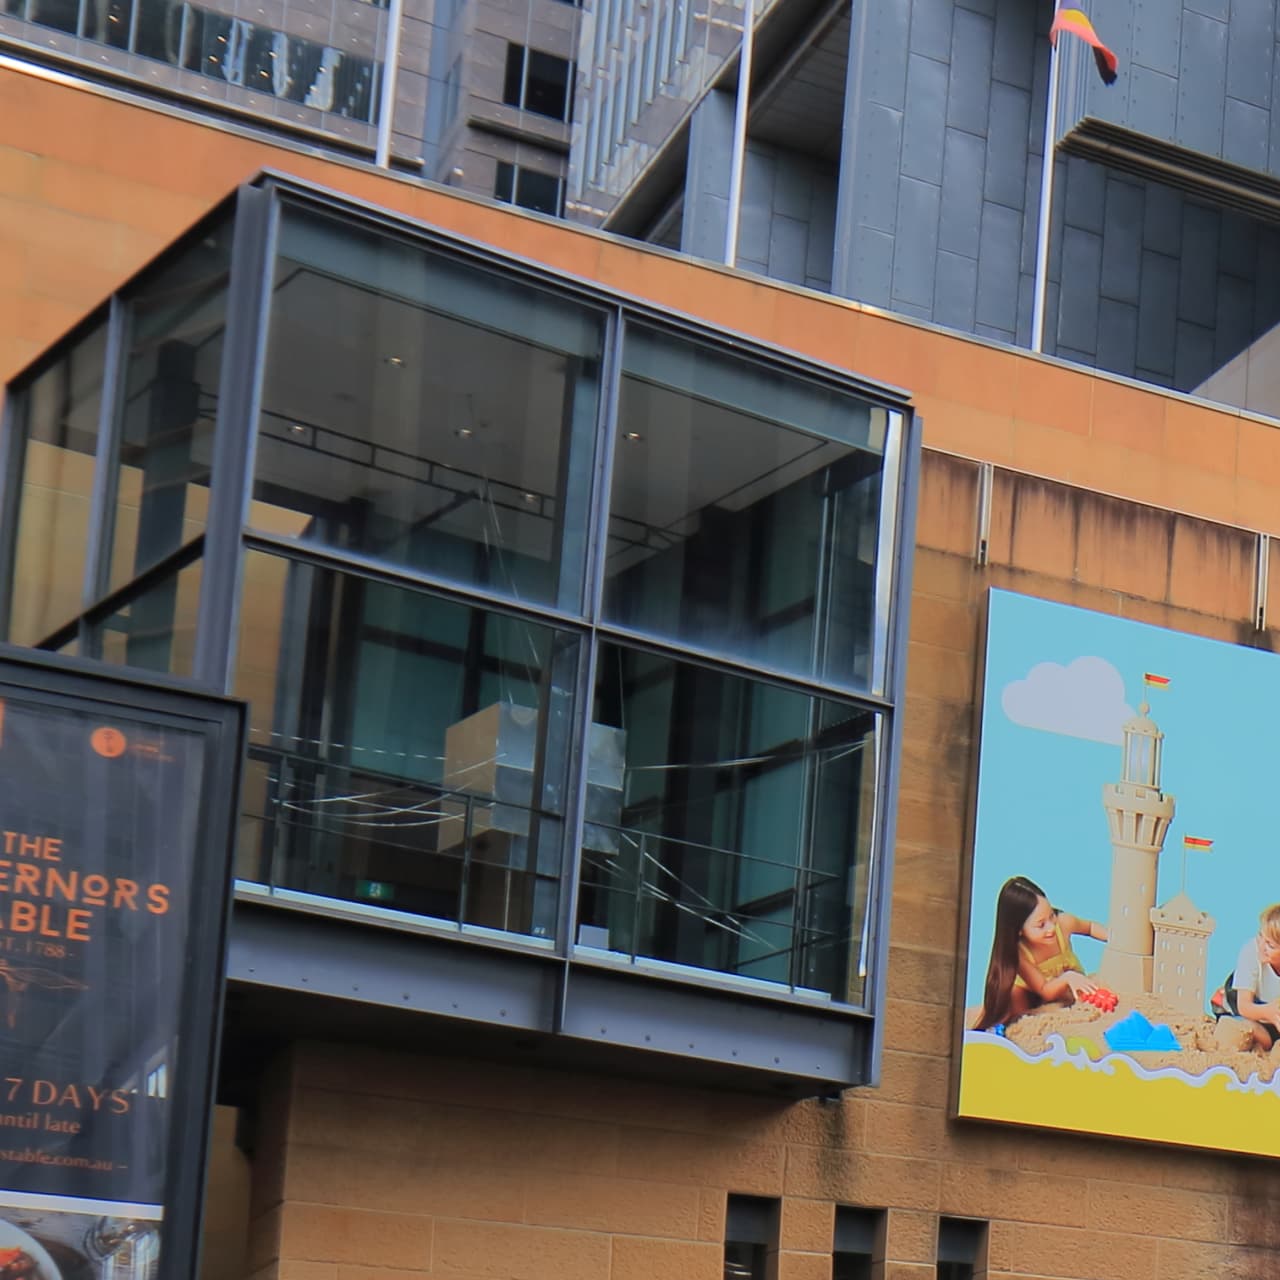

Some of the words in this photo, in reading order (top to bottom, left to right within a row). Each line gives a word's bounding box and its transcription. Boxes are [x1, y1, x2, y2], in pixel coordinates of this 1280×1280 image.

[3, 830, 64, 862] THE
[0, 899, 93, 942] BLE
[4, 1077, 24, 1101] 7
[33, 1079, 131, 1115] DAYS
[45, 1114, 82, 1134] late
